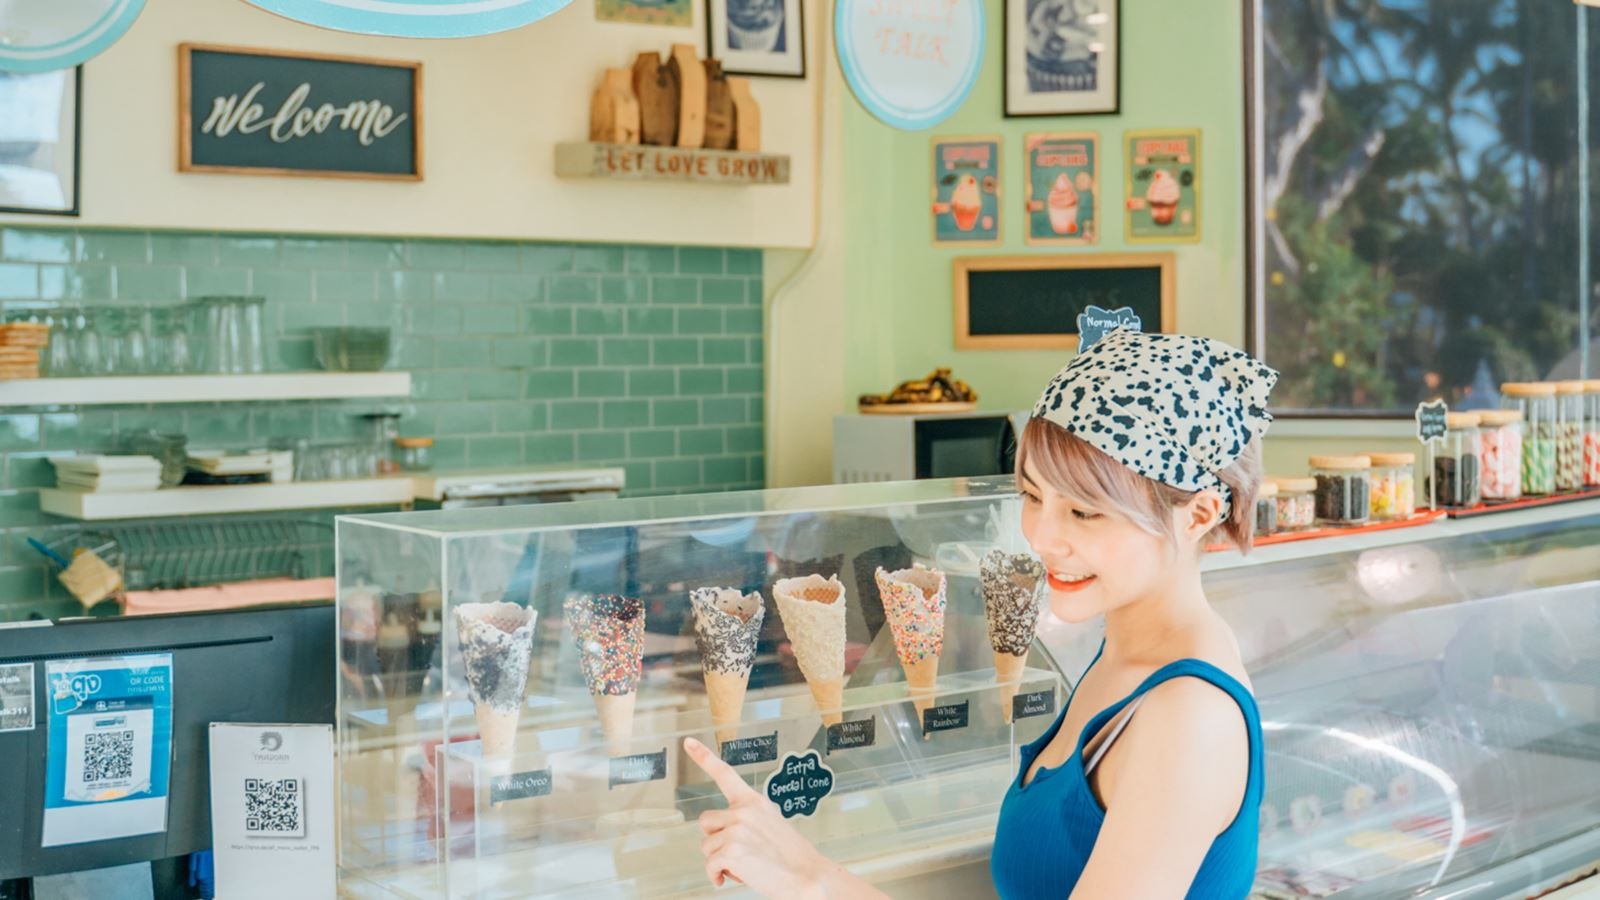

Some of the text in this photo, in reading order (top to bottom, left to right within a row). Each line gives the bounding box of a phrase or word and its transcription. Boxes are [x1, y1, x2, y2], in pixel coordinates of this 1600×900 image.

[874, 26, 951, 68] TALK
[201, 81, 408, 146] Welcome
[606, 149, 779, 178] LET LOVE GROW
[1086, 314, 1121, 329] Normal
[143, 675, 165, 684] CODE
[1027, 693, 1042, 702] Dark
[937, 707, 957, 715] White
[1023, 704, 1047, 714] Almond
[842, 723, 863, 733] White
[932, 717, 960, 728] Rainbow
[729, 738, 773, 752] White Choc
[838, 733, 865, 745] Almond
[742, 751, 760, 763] chip
[786, 758, 816, 776] Extra
[498, 777, 548, 791] White Oreo
[770, 776, 830, 797] Special Cone
